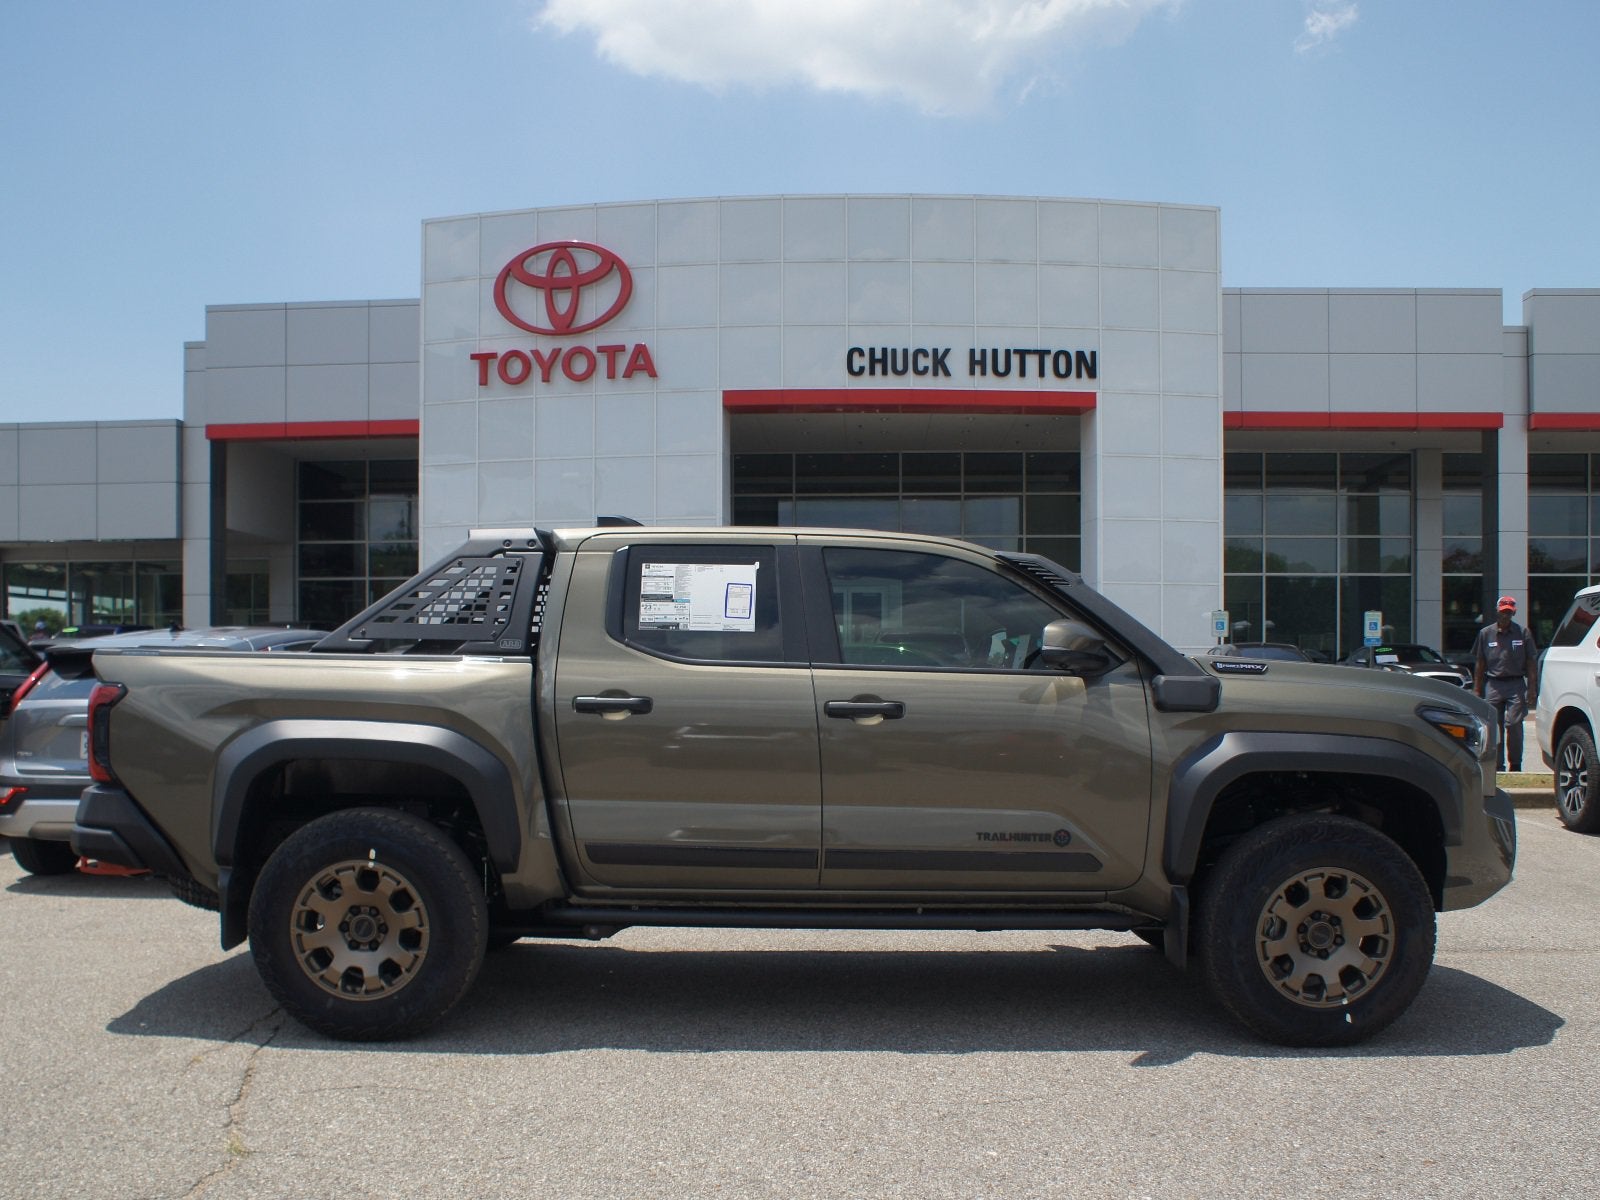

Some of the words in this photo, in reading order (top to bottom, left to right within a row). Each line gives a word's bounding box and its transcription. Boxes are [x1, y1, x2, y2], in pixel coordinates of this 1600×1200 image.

[470, 343, 657, 387] TOYOTA
[846, 346, 951, 378] CHUCK
[969, 348, 1097, 380] HUTTON
[976, 832, 1052, 842] TRAILHUNTER
